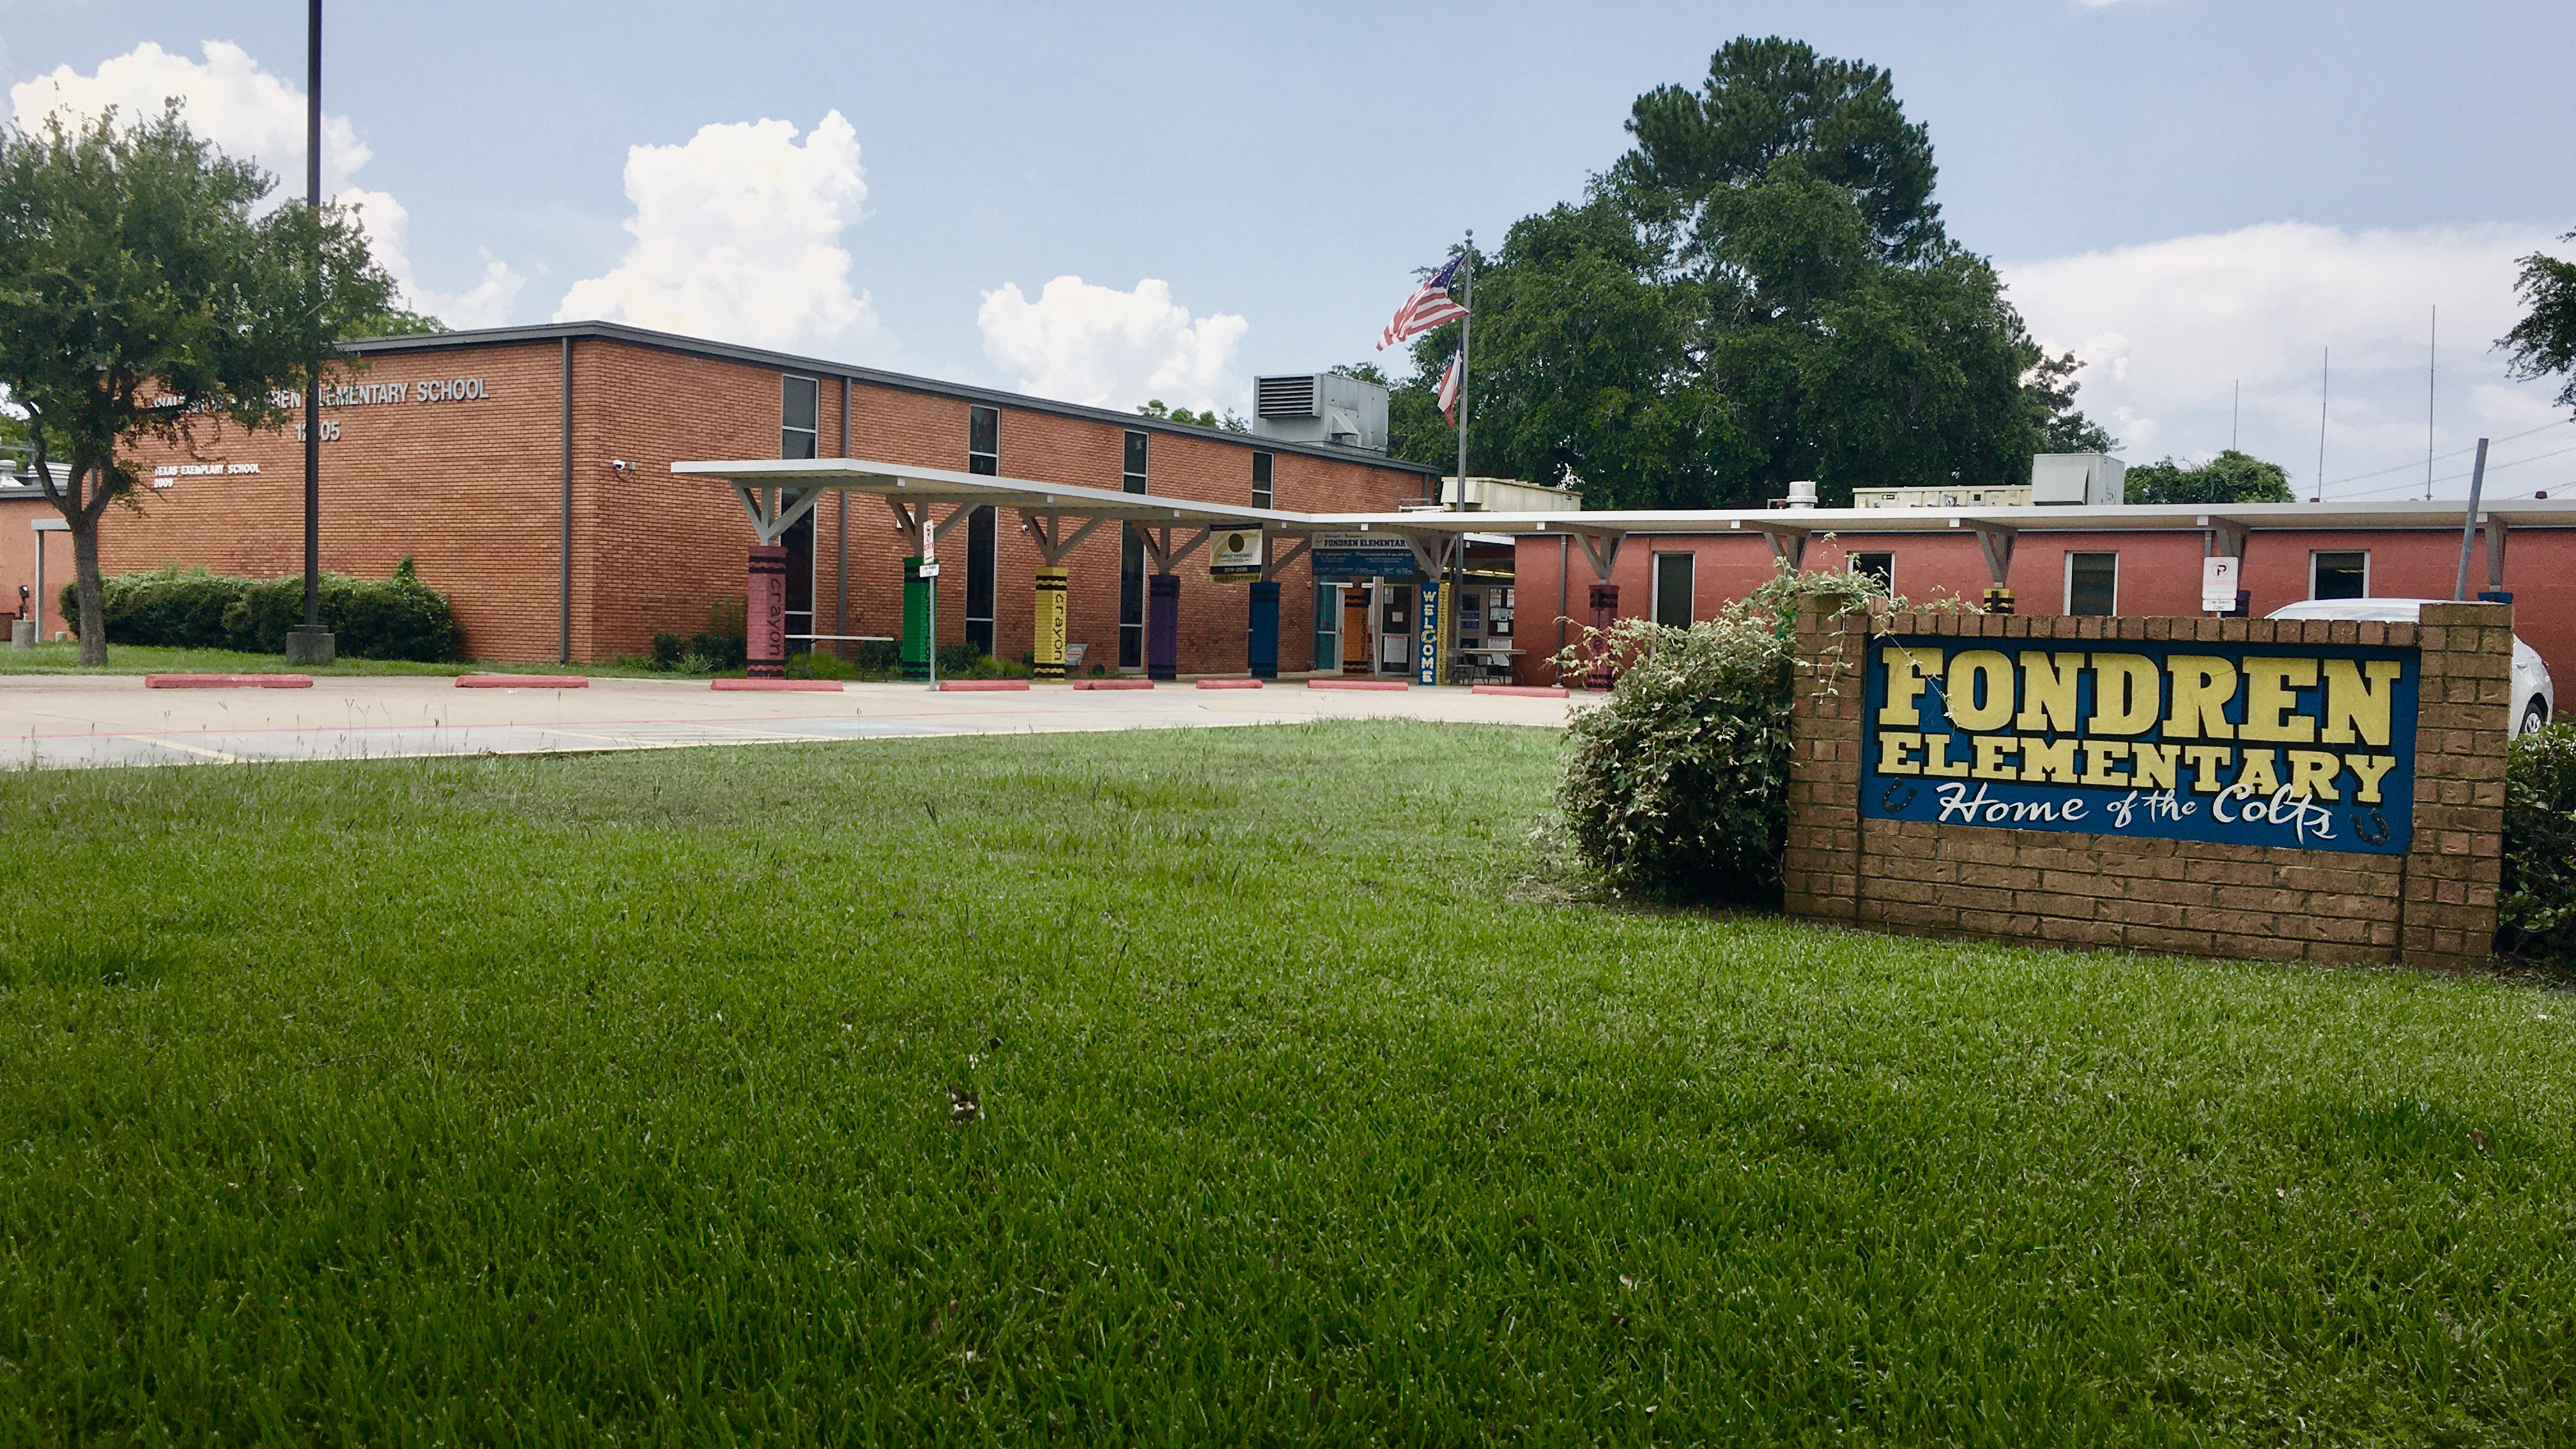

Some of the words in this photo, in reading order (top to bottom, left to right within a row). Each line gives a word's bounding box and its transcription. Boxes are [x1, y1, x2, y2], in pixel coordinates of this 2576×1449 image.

[318, 382, 410, 407] LEMENTARY
[417, 378, 489, 401] SCHOOL
[295, 421, 341, 442] 105
[153, 478, 174, 488] 2009
[155, 466, 178, 476] TEXAS
[181, 464, 224, 475] EXEMPLARY
[227, 463, 261, 474] SCHOOL
[1360, 539, 1406, 547] ELEMENTAR
[767, 578, 781, 656] crayon
[1053, 592, 1064, 661] crayon
[1420, 591, 1437, 683] WELCOME
[1878, 645, 2401, 746] FONDREN
[1877, 731, 2396, 802] ELEMENTARY
[1936, 782, 2090, 823] Home
[2106, 790, 2138, 828] of
[2141, 788, 2198, 823] the
[2212, 783, 2338, 844] Colts
